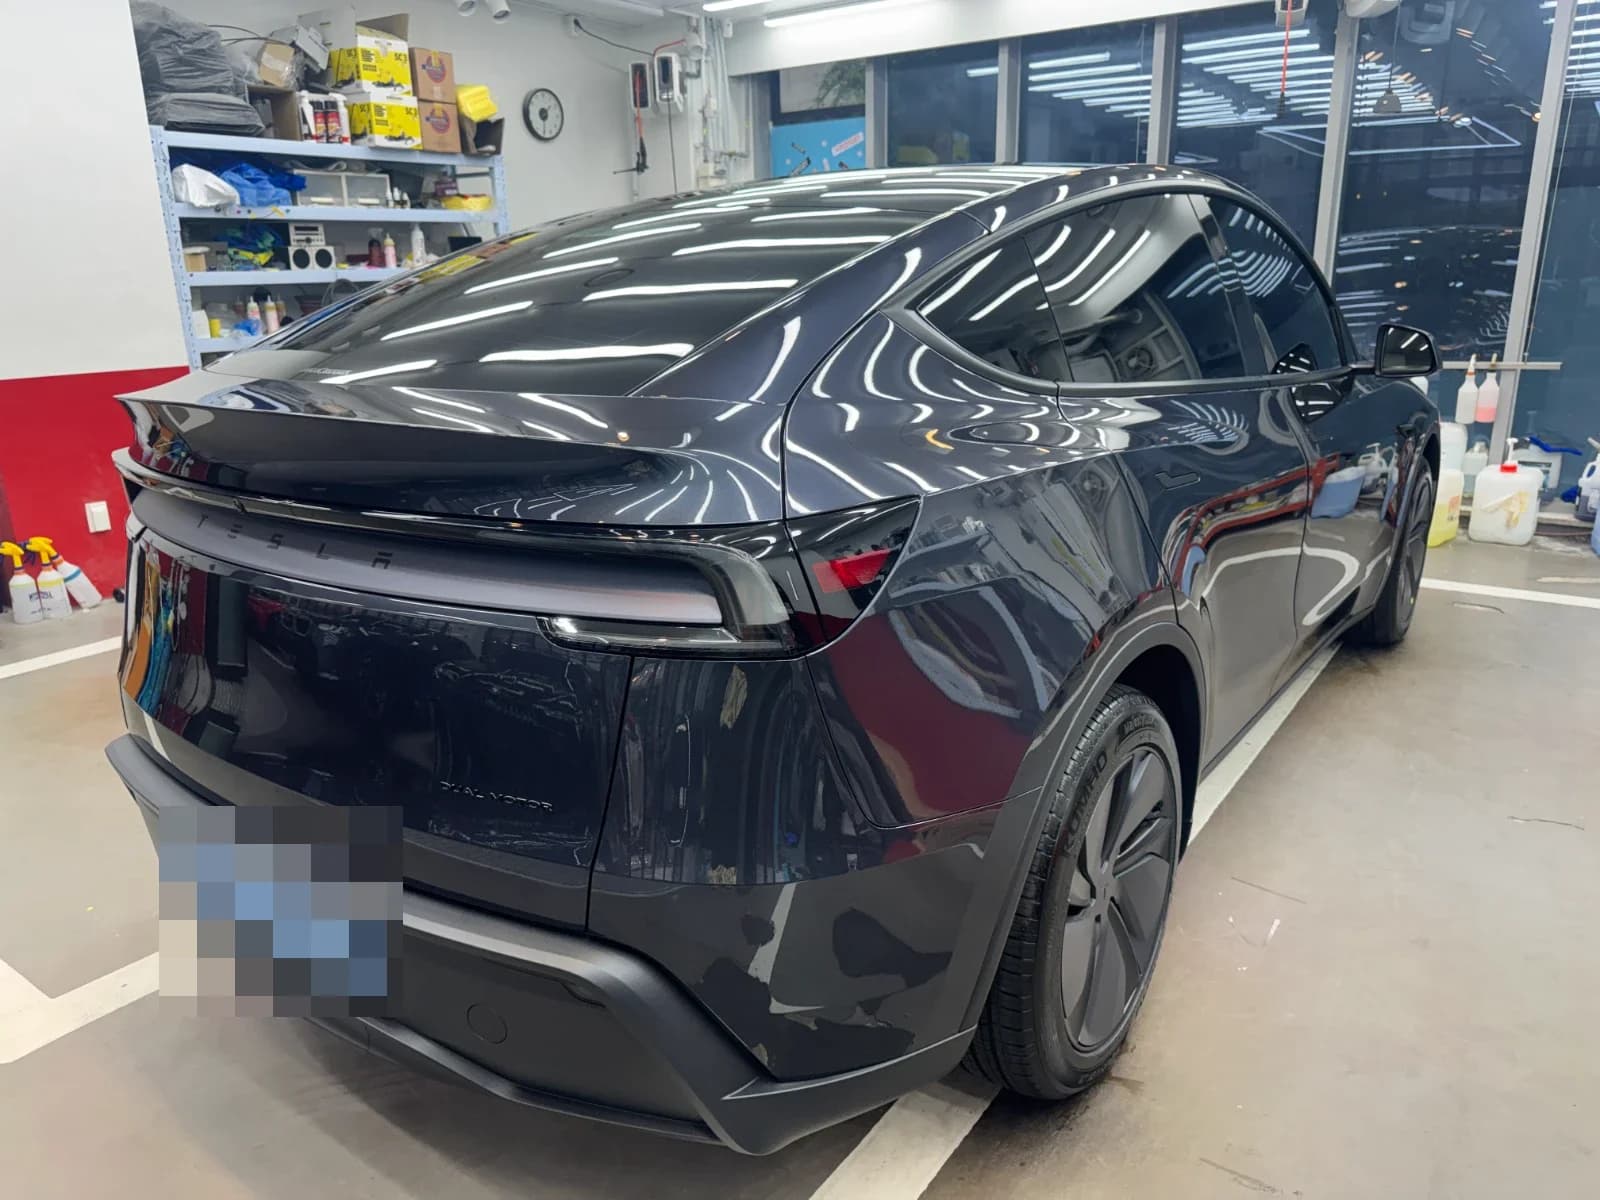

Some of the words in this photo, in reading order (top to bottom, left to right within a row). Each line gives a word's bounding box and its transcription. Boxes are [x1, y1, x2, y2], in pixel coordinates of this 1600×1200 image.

[197, 513, 393, 569] TESLA
[439, 780, 486, 800] DUAL
[486, 789, 553, 813] MOTOR
